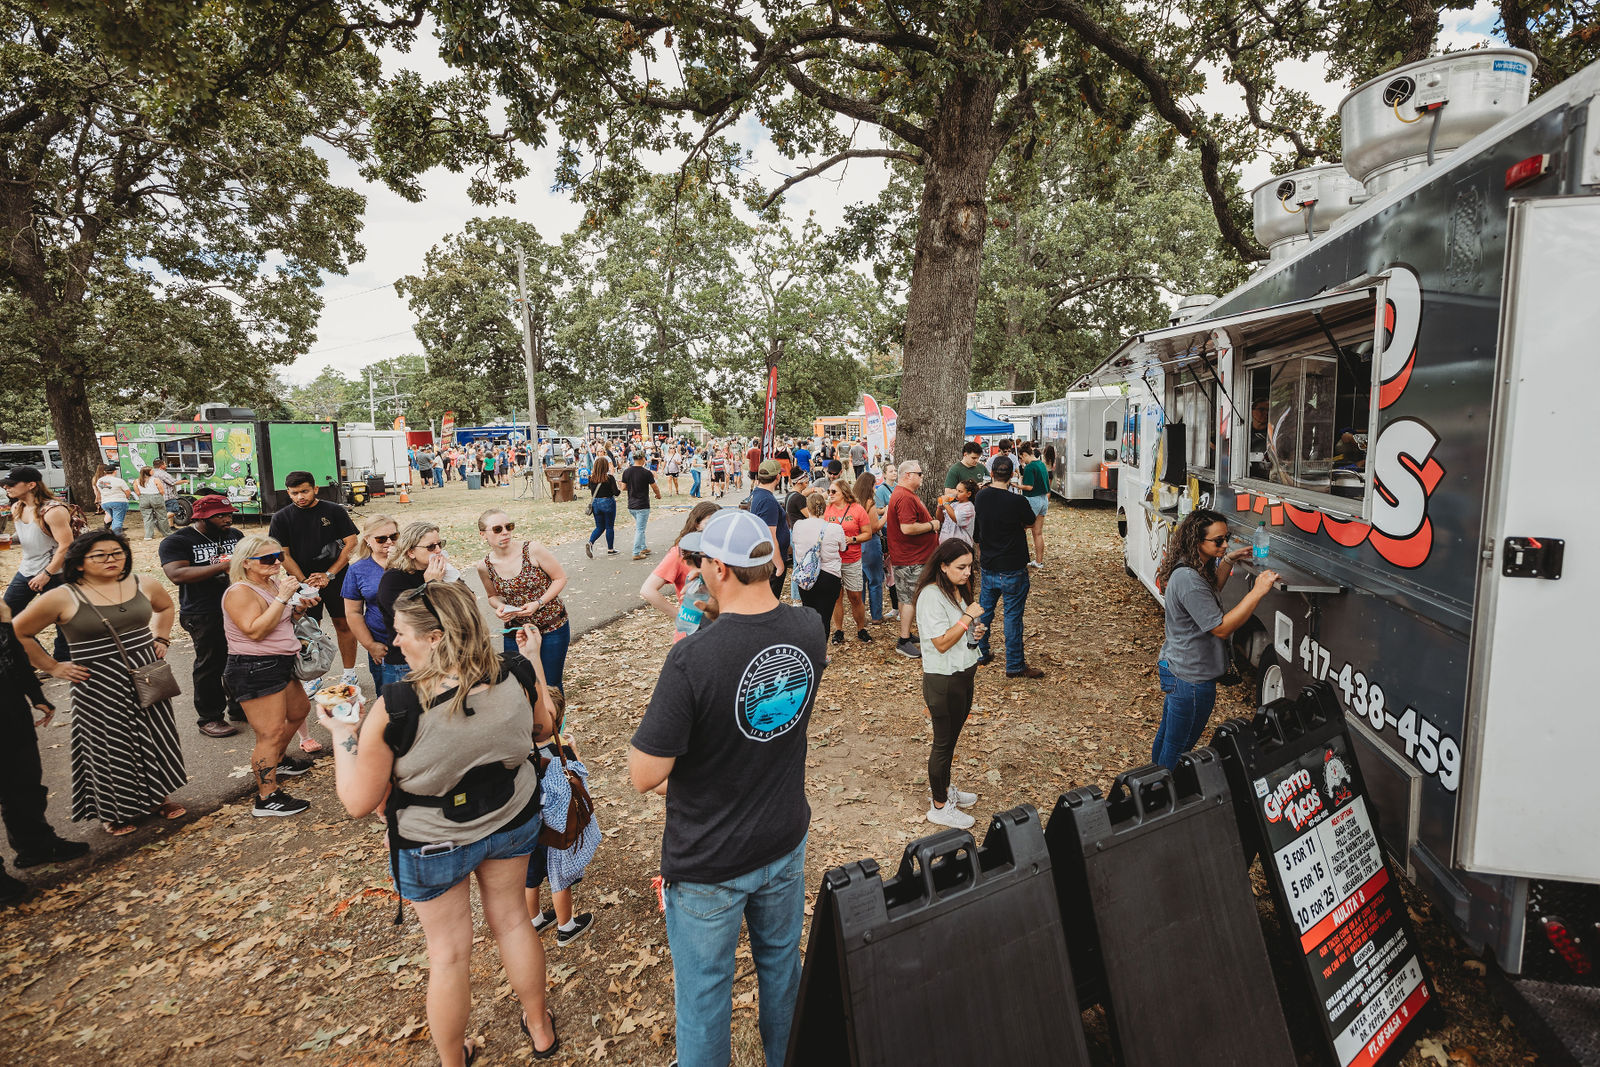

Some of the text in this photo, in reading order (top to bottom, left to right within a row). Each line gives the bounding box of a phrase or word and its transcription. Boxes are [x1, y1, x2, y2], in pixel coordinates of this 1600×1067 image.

[739, 673, 753, 702] HANG
[755, 652, 770, 667] TEN
[1264, 769, 1311, 822] GHETTO
[1284, 788, 1323, 832] TACOS
[1282, 852, 1292, 871] 3
[1291, 845, 1306, 866] FOR
[1290, 879, 1300, 899] 5
[1299, 872, 1314, 892] FOR
[1296, 905, 1310, 928] 10
[1309, 897, 1324, 918] FOR
[1331, 894, 1359, 927] MULITA
[1354, 942, 1373, 965] GARNISHES
[1325, 987, 1343, 1011] GRILLED
[1328, 999, 1346, 1023] GRILLED
[1349, 1012, 1367, 1037] WATER
[1368, 996, 1382, 1016] COKE
[1384, 981, 1396, 999] DIET
[1394, 969, 1407, 988] COKE
[1359, 986, 1405, 1042] DR. PEPPER SPRITE
[1376, 1030, 1386, 1049] OF
[1383, 1012, 1402, 1041] SALSA
